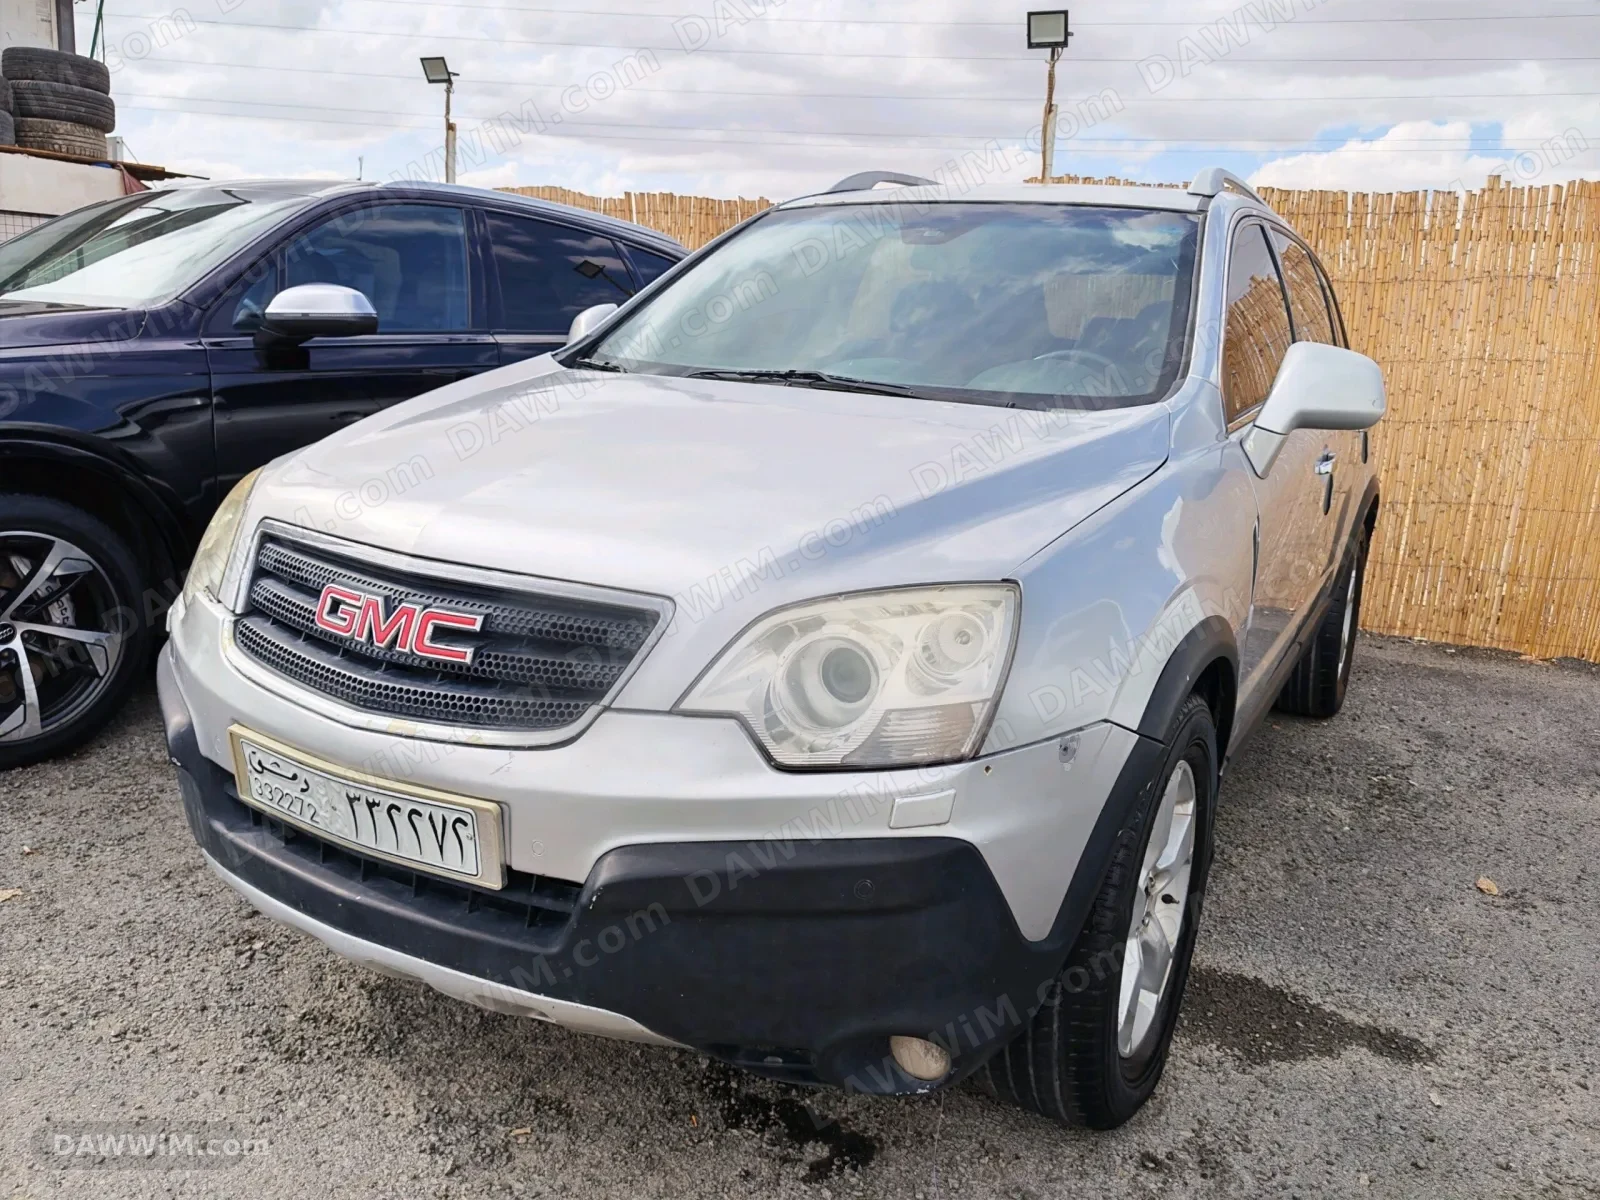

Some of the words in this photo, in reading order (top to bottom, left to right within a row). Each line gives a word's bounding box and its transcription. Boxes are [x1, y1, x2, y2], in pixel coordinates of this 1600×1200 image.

[315, 583, 485, 665] GMC
[249, 750, 311, 794] دمشق
[253, 776, 321, 825] 332272
